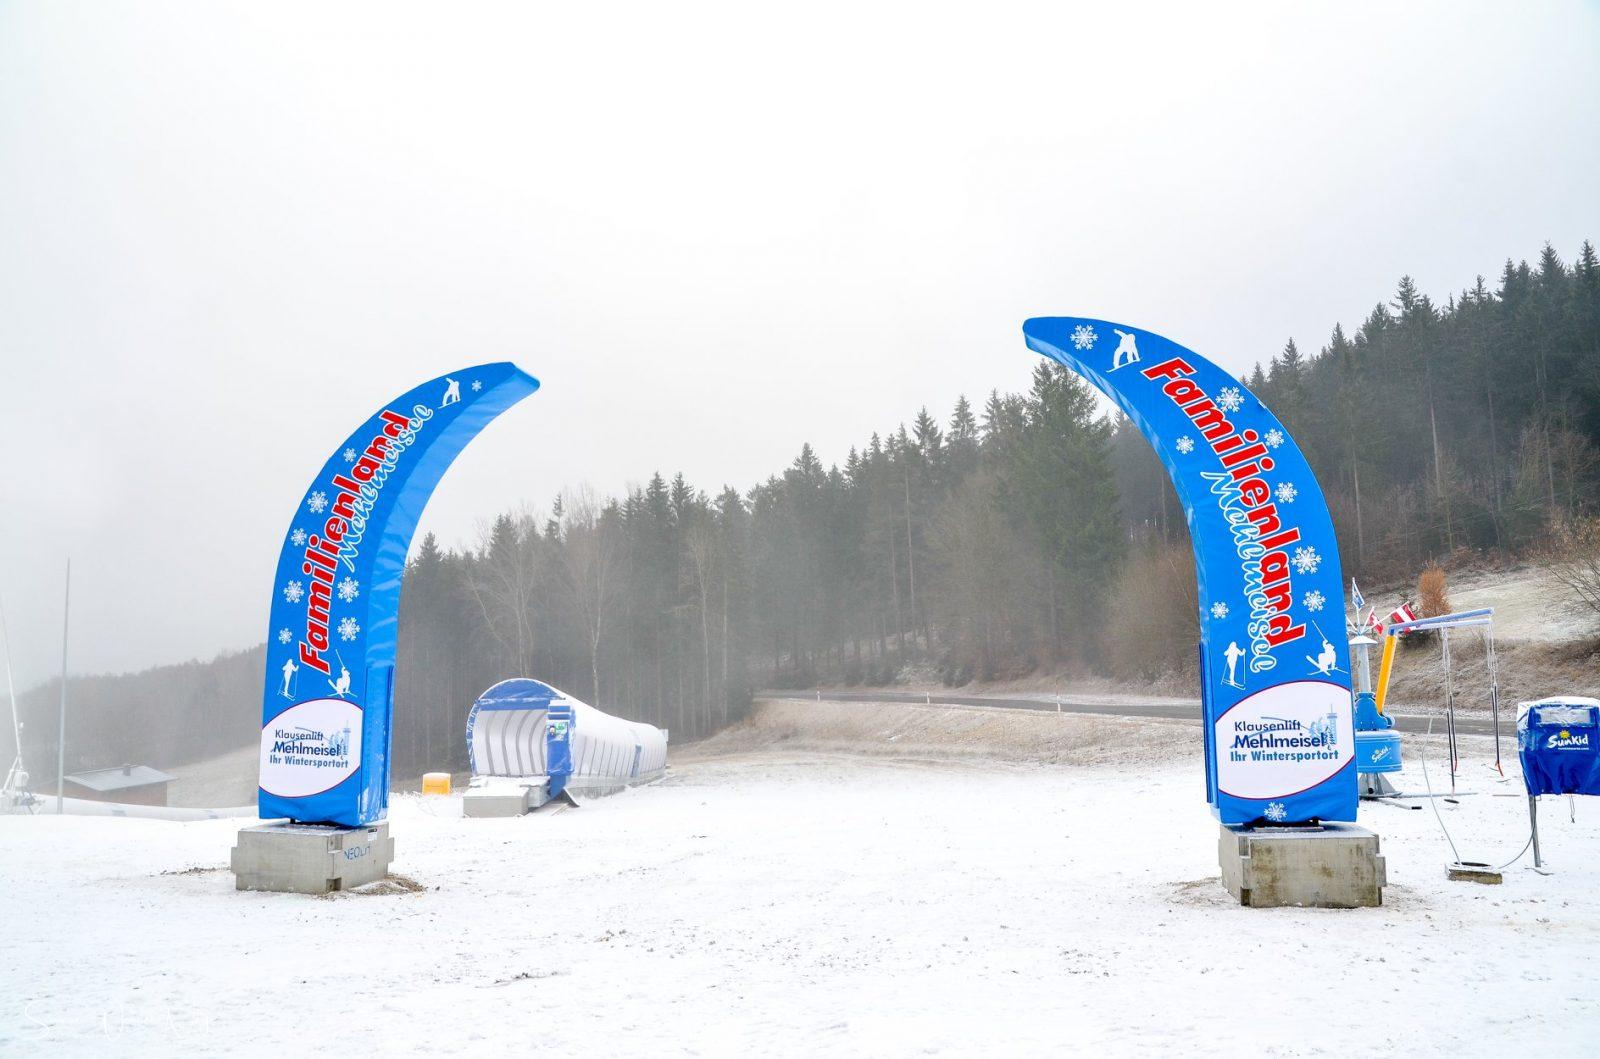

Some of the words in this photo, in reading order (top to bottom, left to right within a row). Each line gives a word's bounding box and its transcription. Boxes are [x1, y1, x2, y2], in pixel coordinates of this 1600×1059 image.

[338, 404, 433, 573] Mehlmeisel
[1140, 356, 1306, 648] Familienland
[299, 409, 410, 675] Familienland
[1200, 471, 1276, 673] Mehlmeisel
[1234, 720, 1301, 731] Klausenlift
[275, 730, 323, 741] Klausenlift
[1234, 733, 1325, 748] Mehlmeisel
[273, 741, 340, 756] Mehlmeisel
[1230, 750, 1247, 762] Ihr
[1251, 750, 1339, 762] Wintersportort
[269, 755, 282, 764] Ihr
[285, 755, 348, 768] Wintersportort
